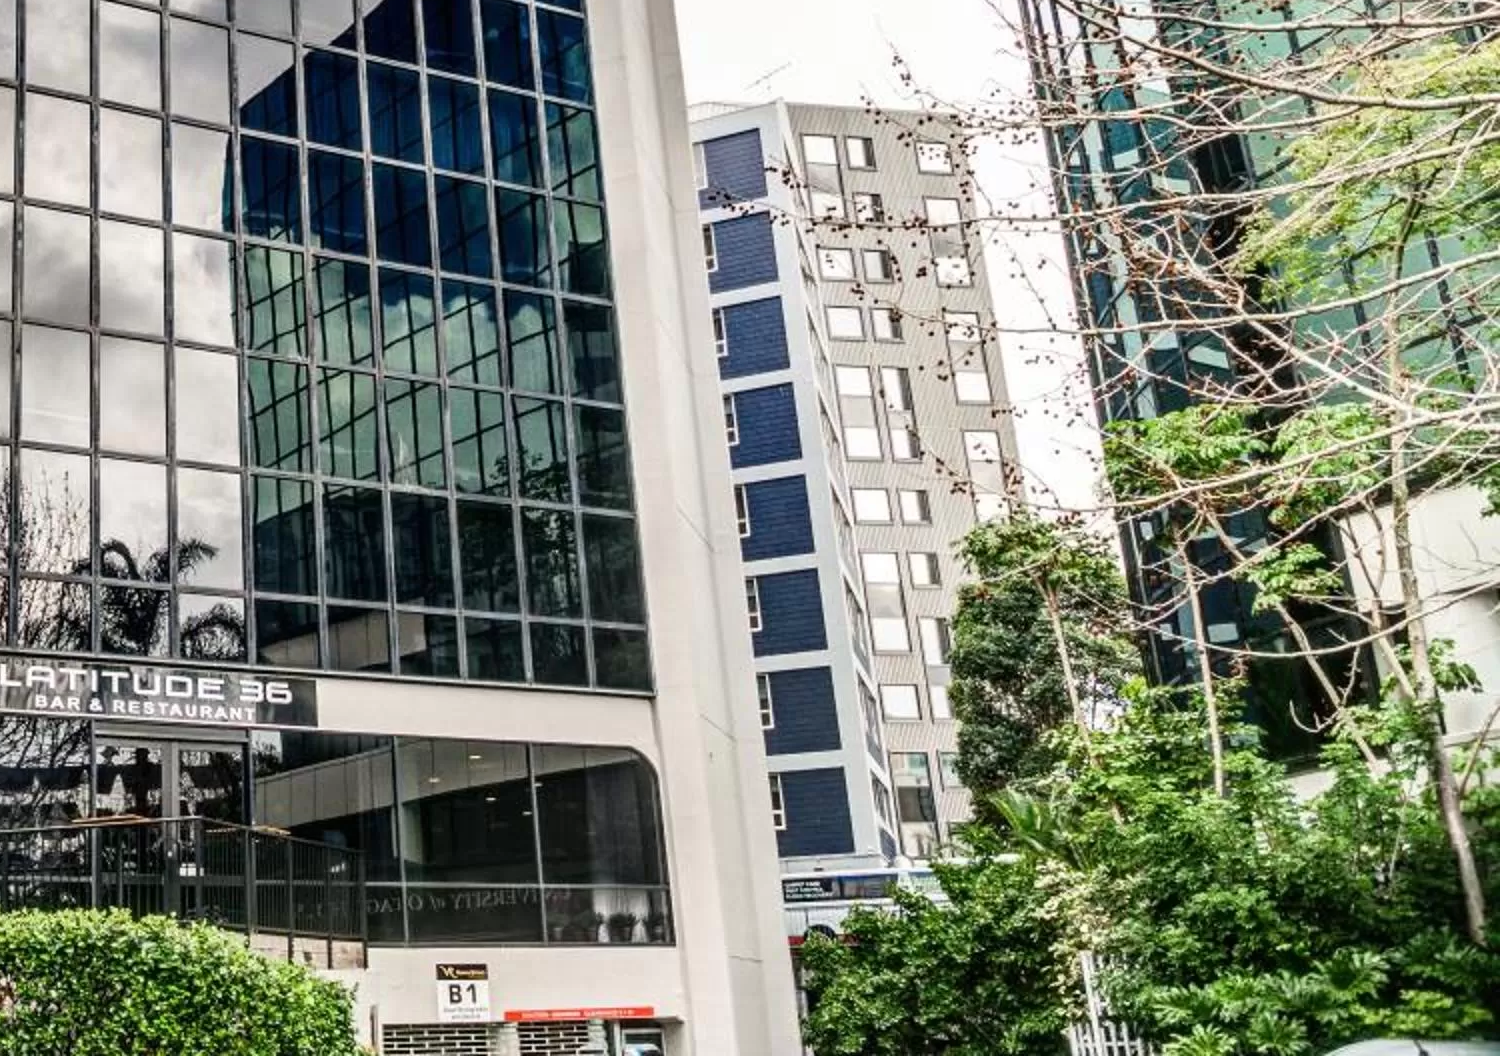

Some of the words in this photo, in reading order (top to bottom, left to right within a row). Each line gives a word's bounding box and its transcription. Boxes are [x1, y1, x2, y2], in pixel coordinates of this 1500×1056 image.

[0, 663, 225, 701] LATITUDE
[239, 681, 293, 705] 36
[34, 694, 81, 713] BAR
[89, 697, 104, 713] &
[112, 699, 256, 722] RESTAURANT
[449, 983, 477, 1004] B1
